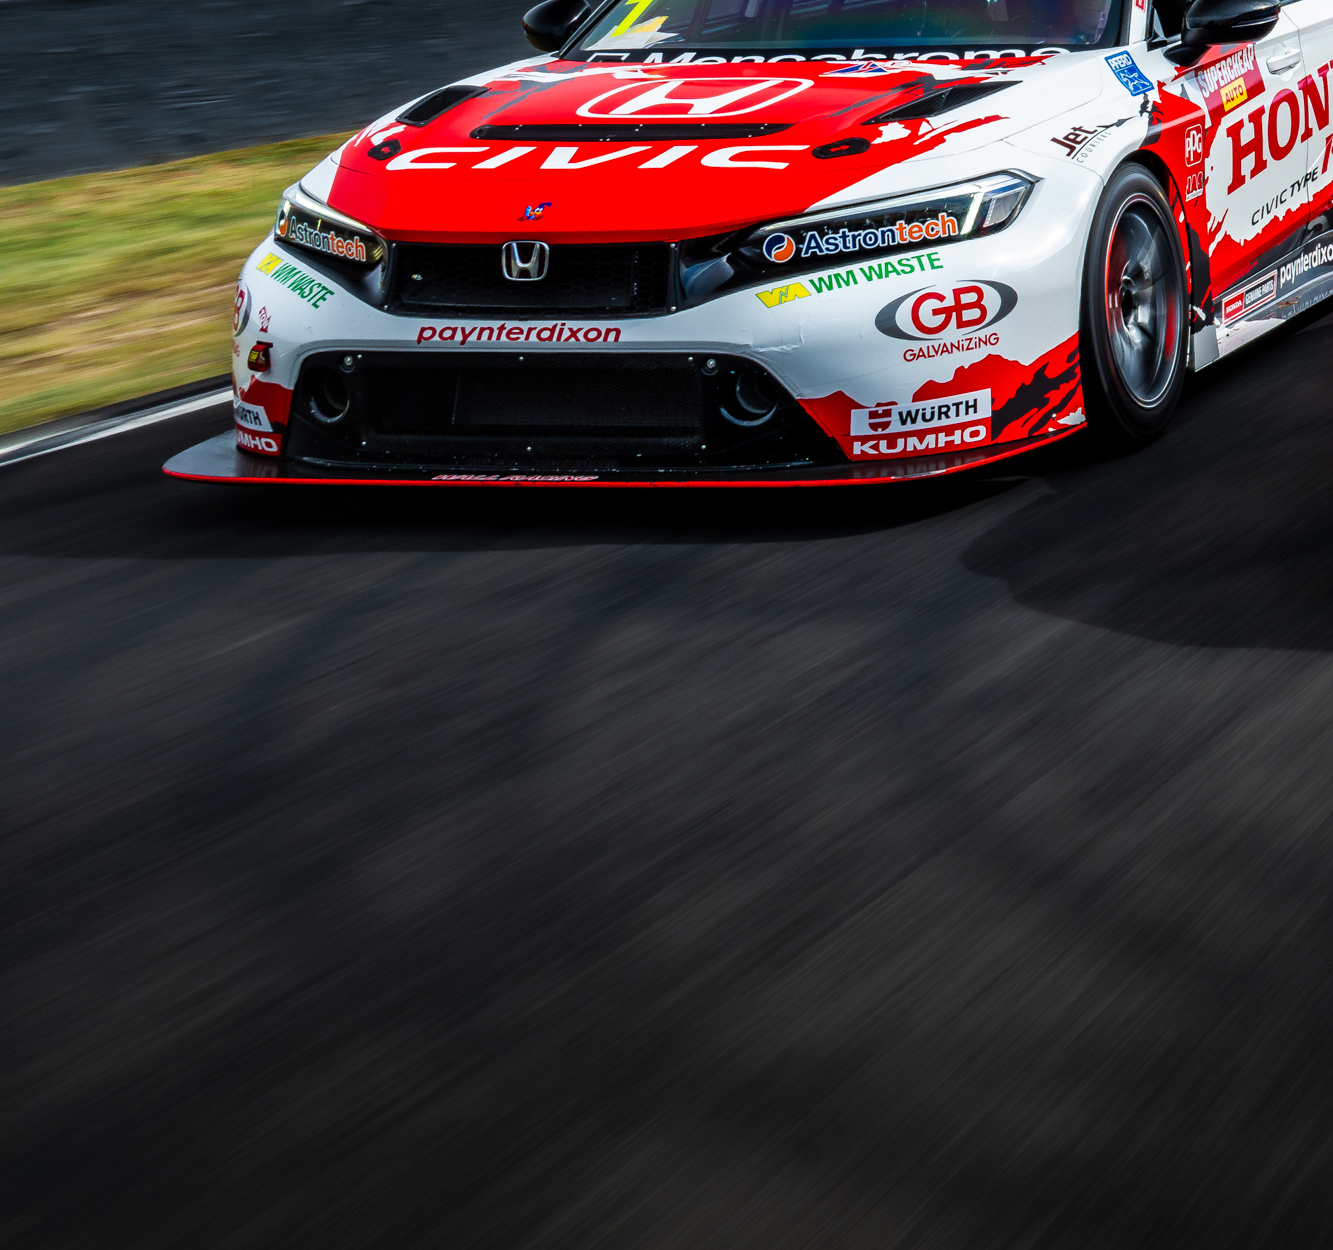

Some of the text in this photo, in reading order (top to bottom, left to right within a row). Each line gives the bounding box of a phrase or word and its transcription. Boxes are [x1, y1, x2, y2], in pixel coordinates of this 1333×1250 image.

[1107, 53, 1132, 71] PFERD
[1198, 43, 1256, 99] SUPERCHEAP
[1225, 84, 1245, 106] AUTO
[385, 145, 810, 170] CIVIC
[1050, 126, 1099, 157] Jet
[1076, 132, 1112, 164] COURIERS
[1186, 130, 1203, 162] PPG
[1251, 188, 1288, 226] CIVIC
[1290, 166, 1319, 197] TYPE
[289, 215, 367, 262] Astrontech
[801, 213, 959, 258] Astrontech
[808, 253, 944, 294] WM WASTE
[293, 270, 335, 310] WASTE
[910, 285, 988, 335] GB
[417, 322, 621, 346] paynterdixon
[898, 399, 978, 427] WÜRTH
[852, 424, 987, 455] KUMHO
